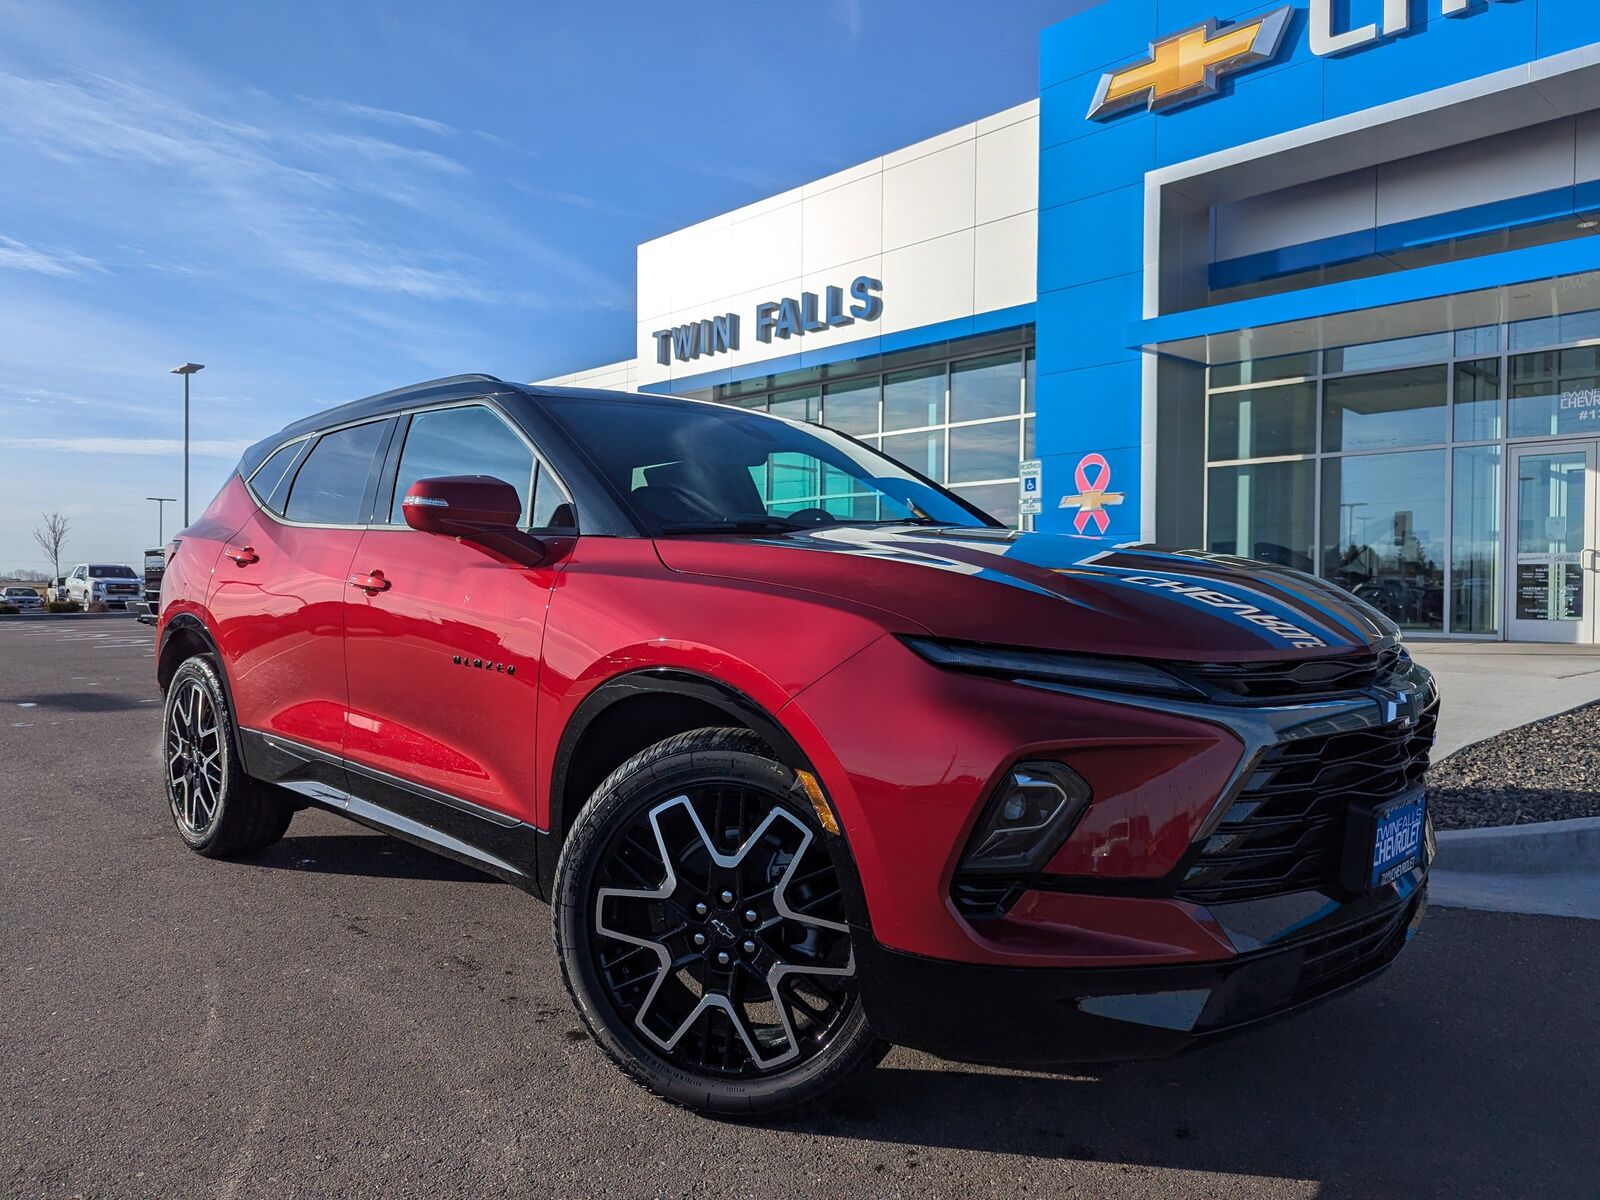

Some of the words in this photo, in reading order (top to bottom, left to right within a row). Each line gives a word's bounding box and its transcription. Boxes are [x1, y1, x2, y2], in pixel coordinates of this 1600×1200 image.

[652, 313, 740, 366] TWIN
[756, 276, 883, 344] FALLS
[453, 655, 516, 675] BLAZER
[1373, 821, 1421, 866] CHEVROLET
